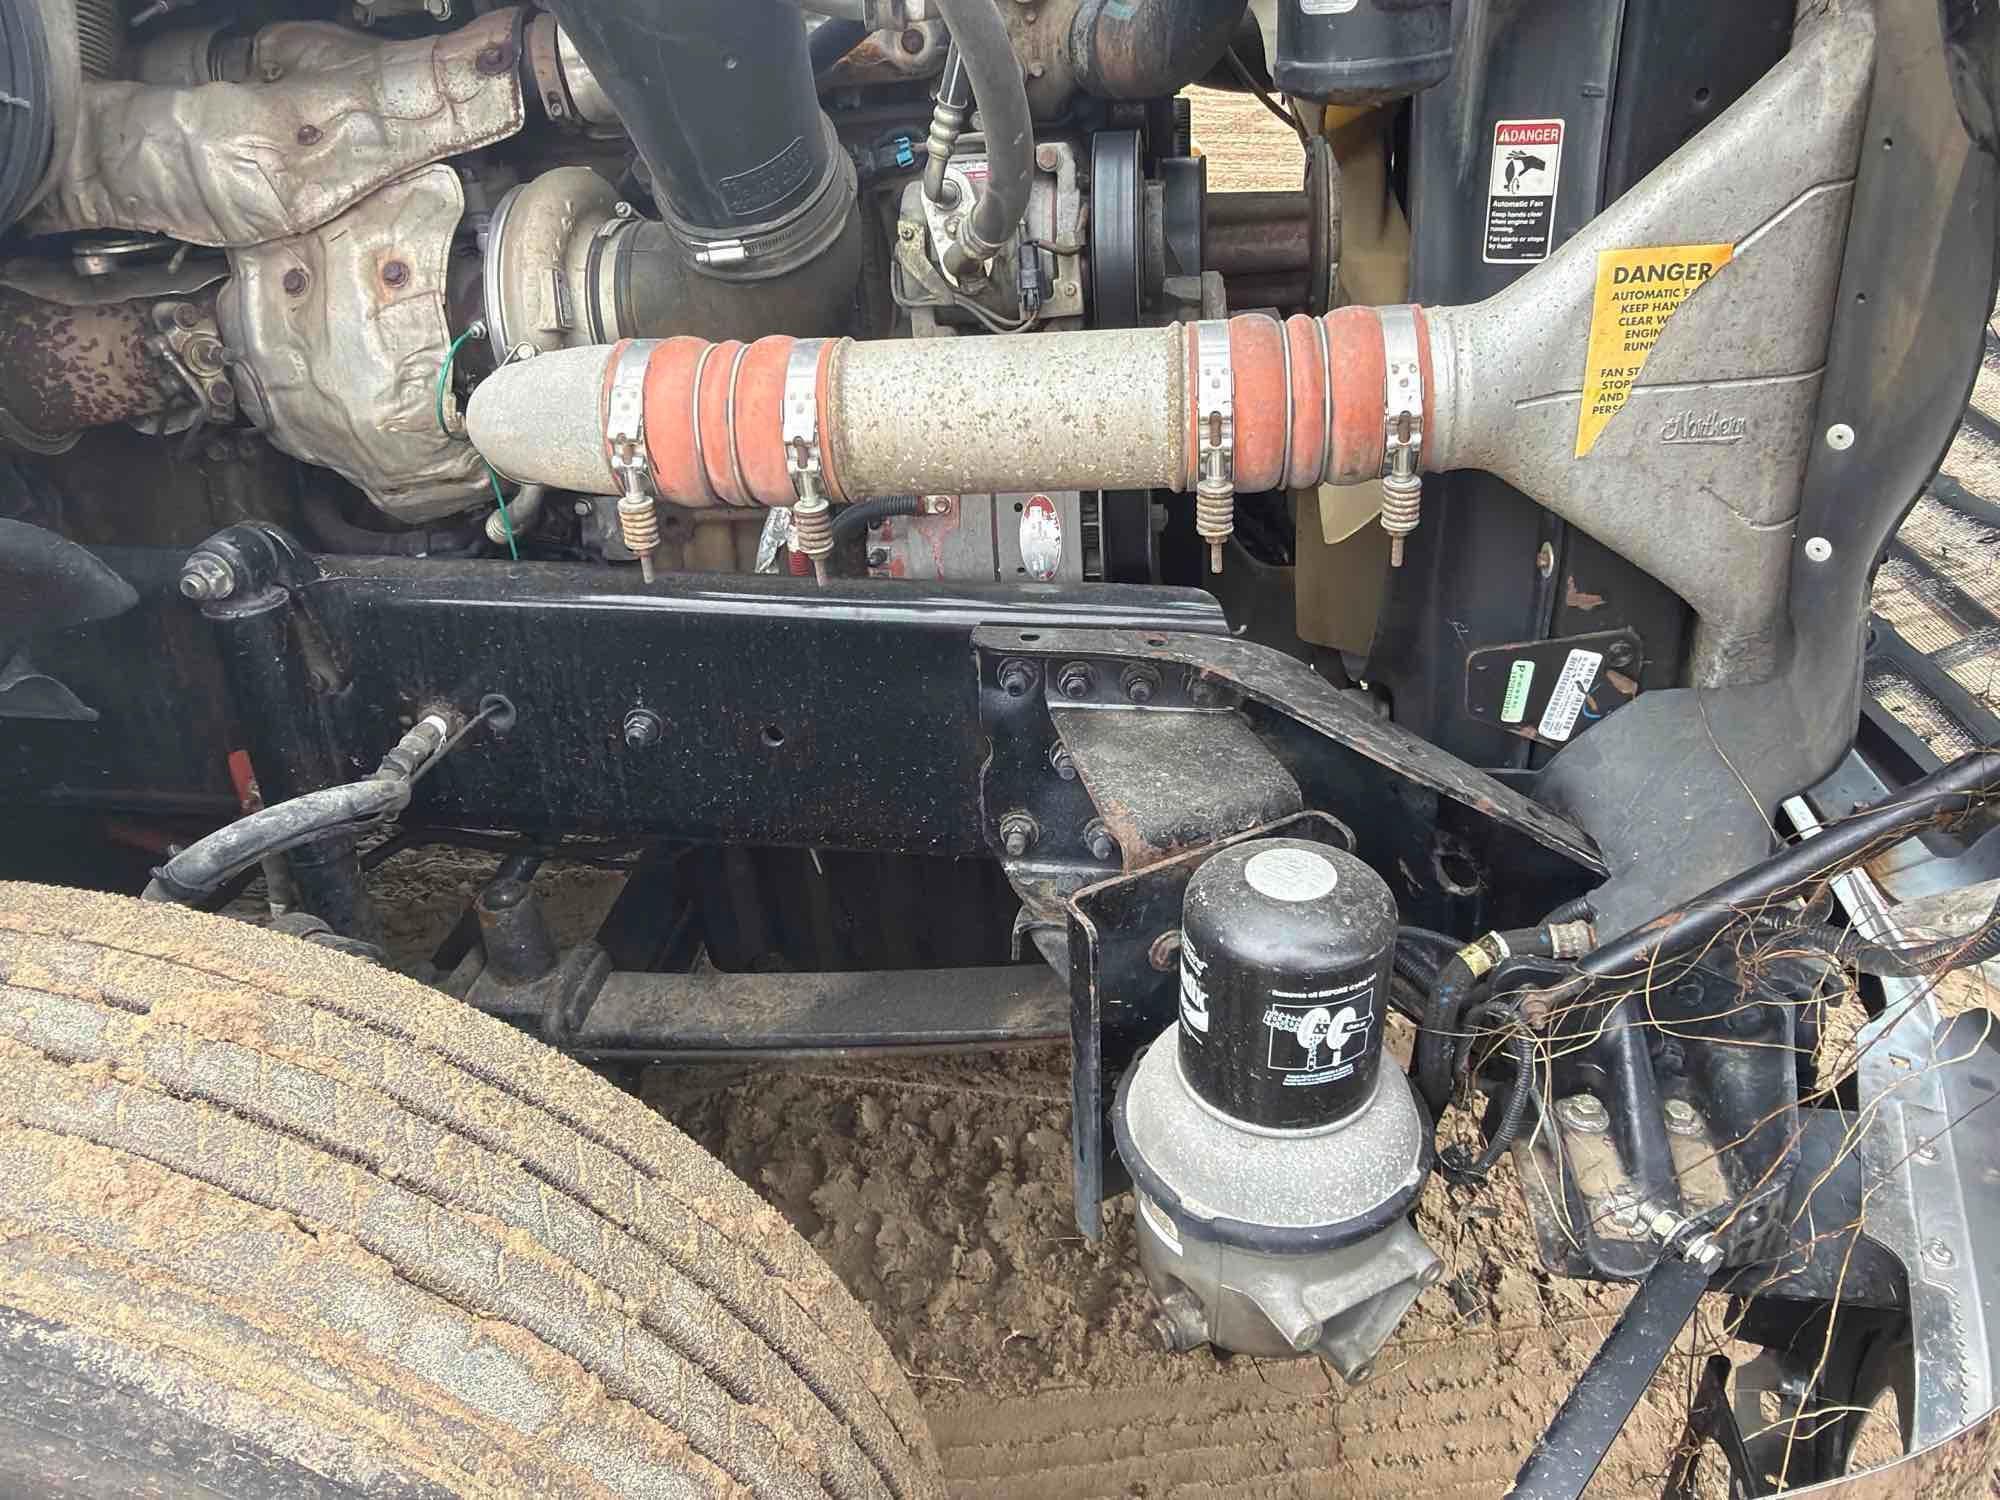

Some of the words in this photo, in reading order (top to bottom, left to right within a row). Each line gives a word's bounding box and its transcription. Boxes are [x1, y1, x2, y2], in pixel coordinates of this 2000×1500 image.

[1510, 128, 1559, 142] DANGER
[1492, 200, 1528, 208] Automatic
[1529, 200, 1544, 208] Fan
[1613, 262, 1713, 284] DANGER
[1612, 288, 1680, 301] AUTOMATIC
[1621, 303, 1649, 314] KEEP
[1618, 316, 1653, 327] CLEAR
[1600, 368, 1624, 378] FAN
[1599, 392, 1624, 403] AND
[1308, 991, 1318, 999] oil
